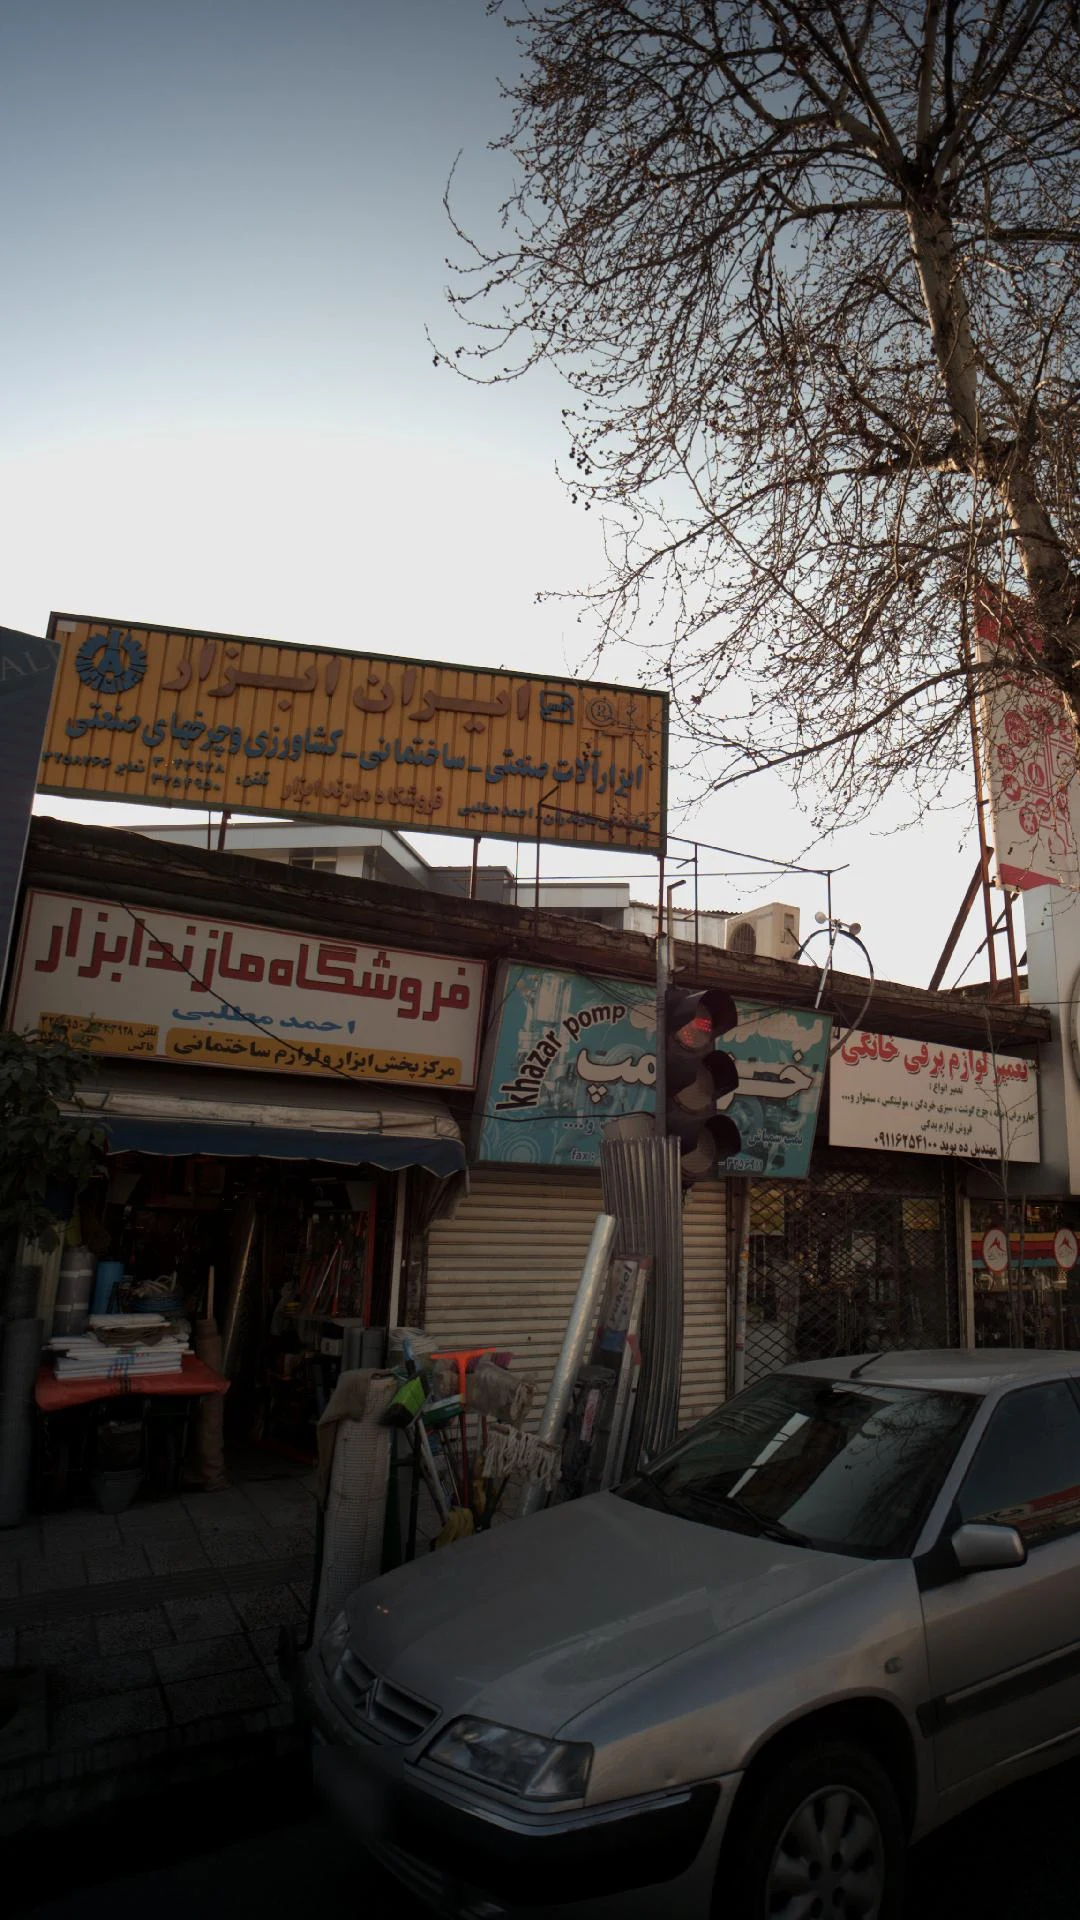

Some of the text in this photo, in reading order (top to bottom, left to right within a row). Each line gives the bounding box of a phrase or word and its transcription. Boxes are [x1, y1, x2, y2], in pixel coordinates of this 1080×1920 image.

[161, 640, 341, 711] ابزار
[352, 668, 532, 735] ایران
[65, 702, 142, 738] صنعتی
[245, 726, 344, 761] کشاورزی
[359, 736, 466, 770] ساختمانی
[485, 749, 549, 784] صنعتی
[502, 806, 533, 819] احمد
[268, 943, 470, 1021] فروشگاه
[172, 1003, 356, 1035] احمد مطلبی
[563, 1004, 626, 1041] pomp
[174, 1035, 270, 1058] ساختمانی
[336, 1051, 374, 1073] ابزار
[841, 1032, 900, 1067] خانگی
[904, 1041, 945, 1079] برقی
[374, 1056, 419, 1079] پخش
[420, 1059, 456, 1080] مرکز
[496, 1030, 562, 1111] khazar
[993, 1062, 1029, 1087] تعمیر
